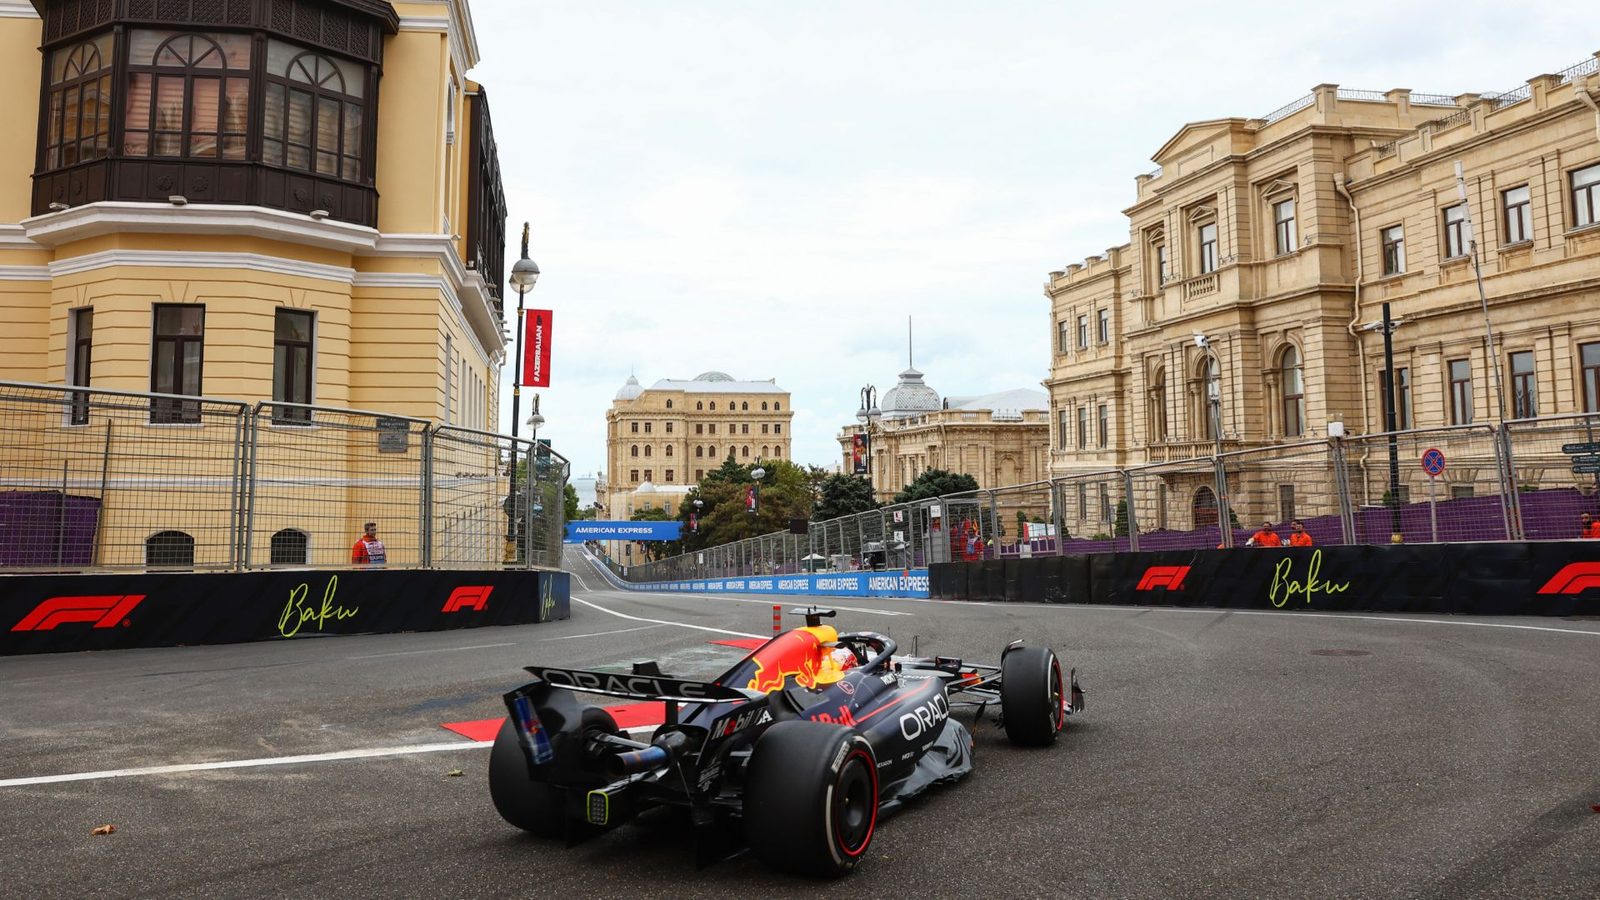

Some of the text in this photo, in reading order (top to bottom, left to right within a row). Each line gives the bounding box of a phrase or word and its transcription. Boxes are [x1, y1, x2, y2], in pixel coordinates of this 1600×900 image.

[816, 578, 858, 591] AMERICAN EXPRESS
[869, 576, 898, 591] AMERICAN
[1269, 549, 1350, 608] Baku
[278, 575, 359, 638] Baku
[711, 709, 754, 740] Mobil
